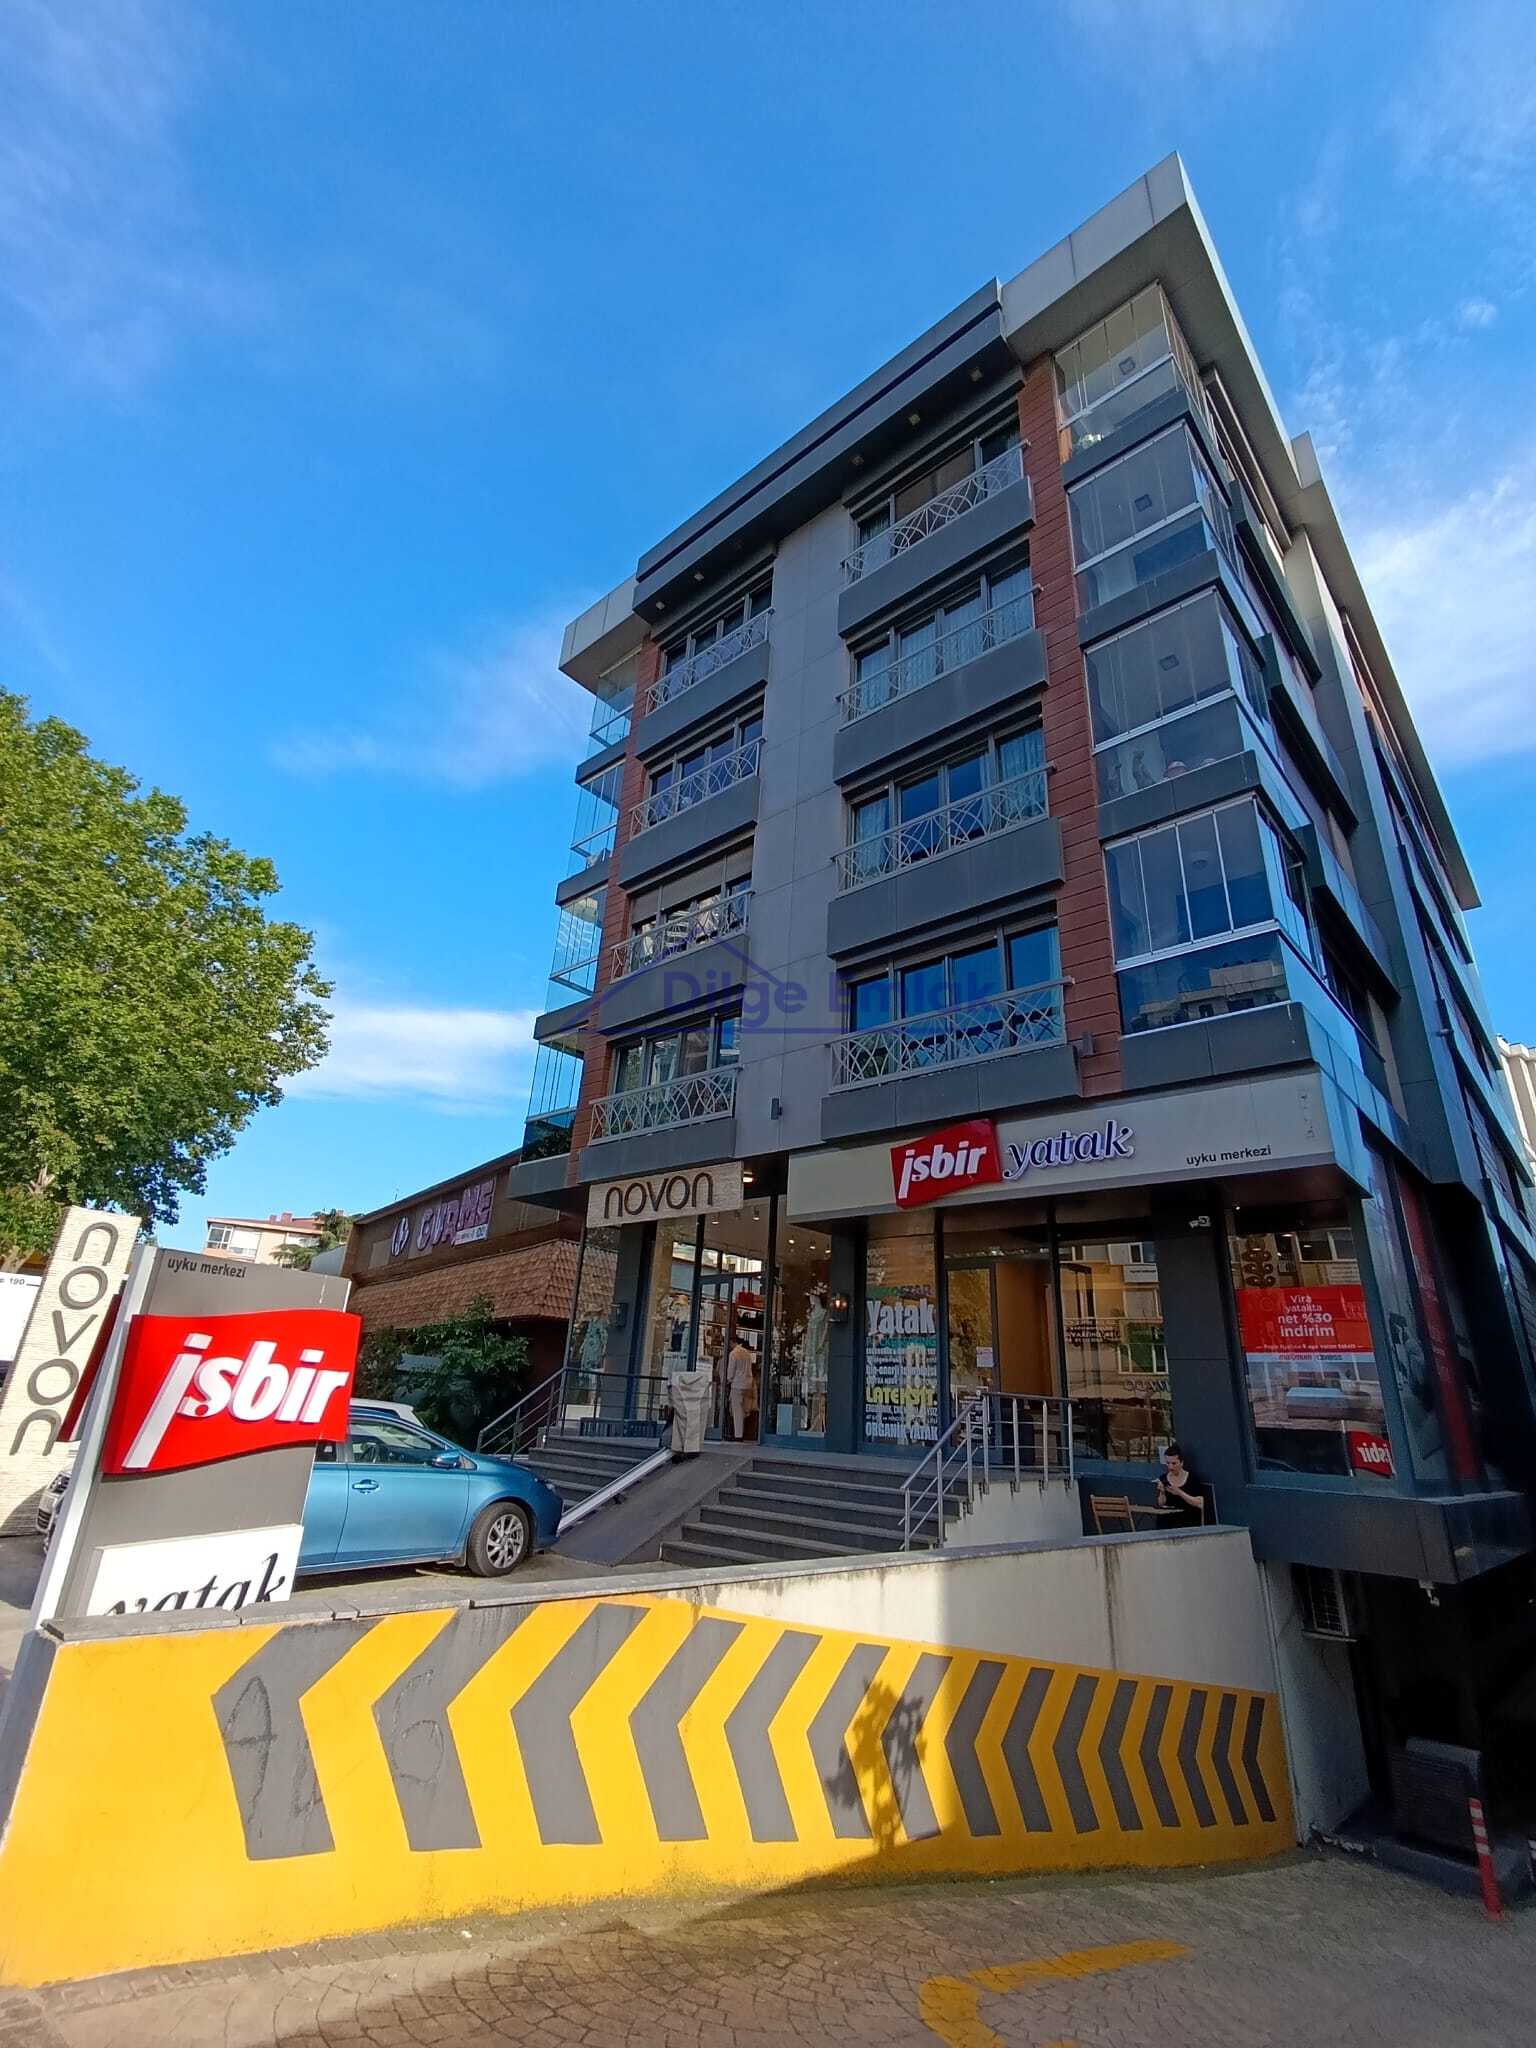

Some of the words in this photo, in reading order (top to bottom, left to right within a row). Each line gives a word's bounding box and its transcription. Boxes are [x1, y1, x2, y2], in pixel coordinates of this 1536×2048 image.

[1002, 1120, 1135, 1180] yatak
[1186, 1152, 1217, 1166] uyku
[1220, 1145, 1272, 1161] merkezi
[604, 1172, 713, 1219] novon
[167, 1256, 198, 1272] uyku
[200, 1262, 247, 1279] merkezi
[866, 1298, 936, 1334] Yatak
[1278, 1314, 1299, 1324] net
[1302, 1313, 1332, 1323] %30
[9, 1222, 119, 1457] novon
[1280, 1325, 1335, 1337] indirim
